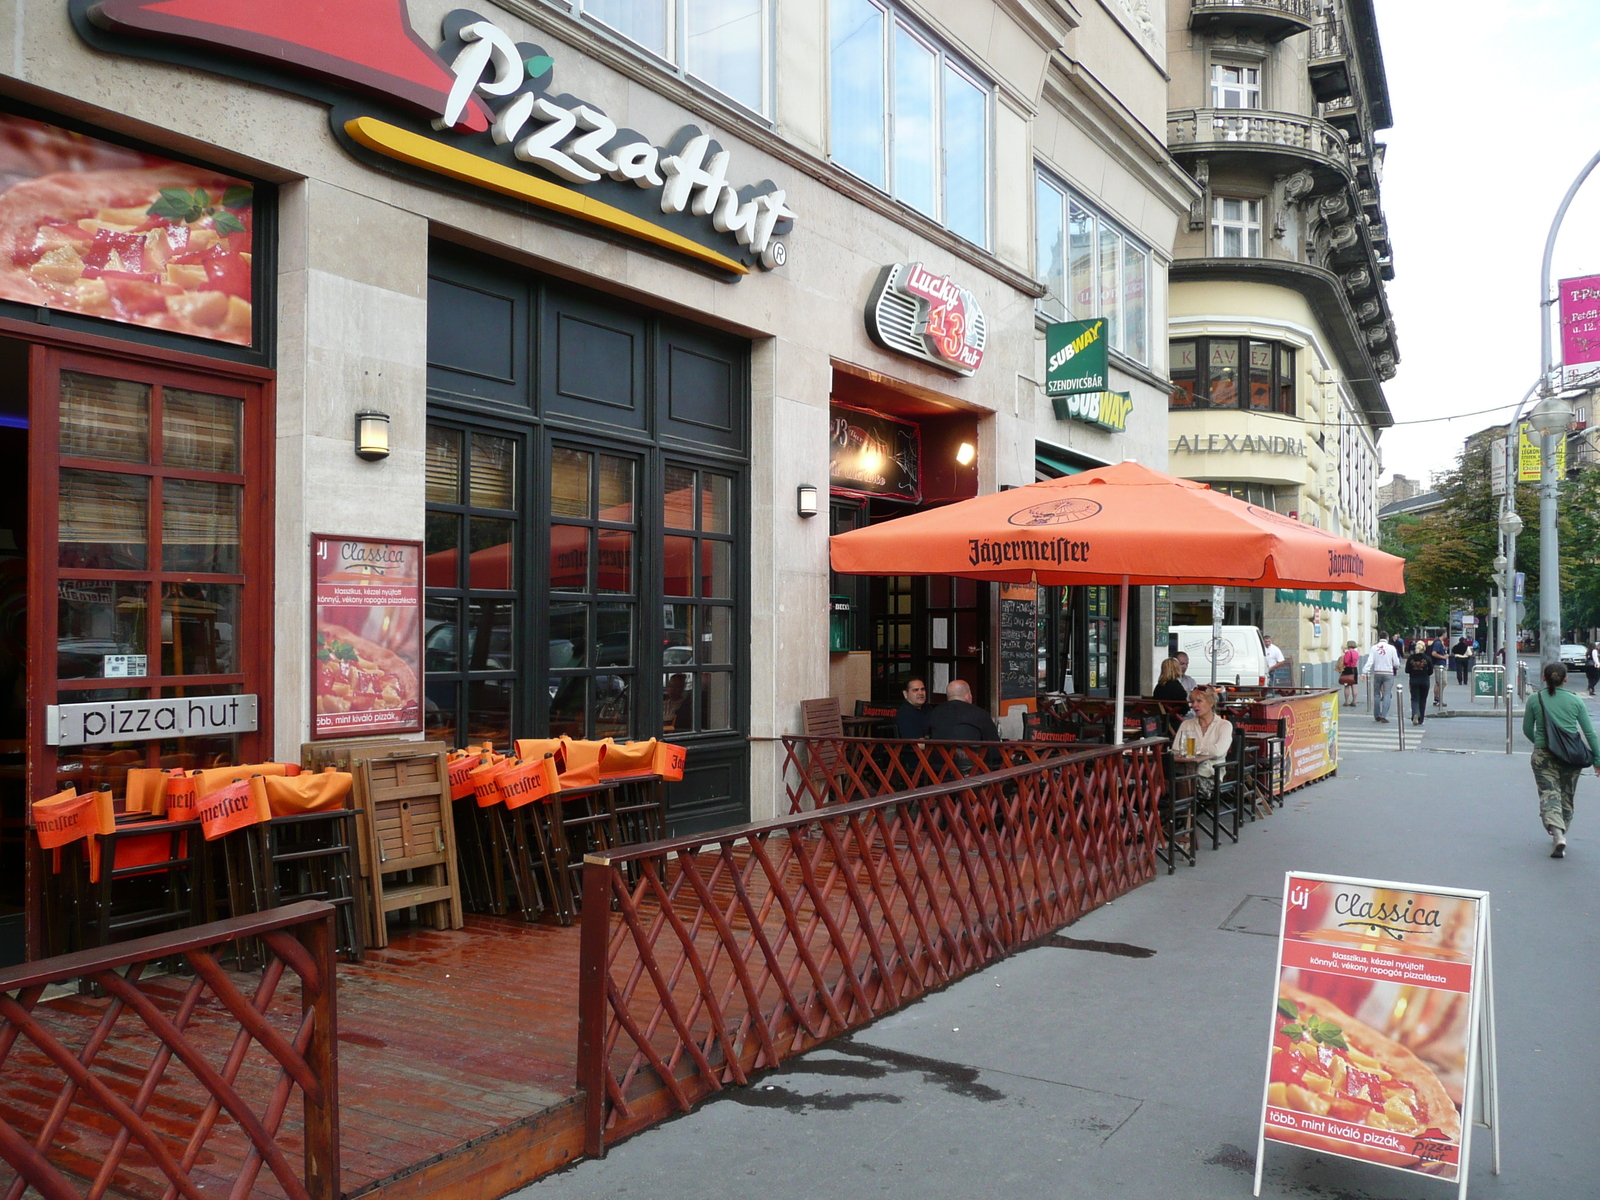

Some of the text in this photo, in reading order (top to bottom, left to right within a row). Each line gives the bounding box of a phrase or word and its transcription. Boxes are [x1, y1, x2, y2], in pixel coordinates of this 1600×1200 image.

[431, 21, 798, 254] Pizza Hut
[910, 263, 961, 311] Lucky
[930, 305, 965, 357] 13
[1583, 322, 1598, 332] 12.
[959, 346, 980, 365] Pub
[1048, 320, 1103, 373] SUBWAY
[1048, 373, 1103, 392] SZENDVICSBÁR
[1067, 391, 1133, 430] SUBWAY
[1174, 433, 1308, 458] ALEXANDRA
[341, 542, 405, 563] Classica
[968, 537, 1090, 566] Jägermeister
[83, 697, 239, 742] pizza hut
[352, 713, 373, 723] kiváló
[1290, 885, 1442, 928] új Classica
[1309, 956, 1447, 983] könnyű, vékony ropogós pizzatészta
[1332, 951, 1425, 971] klasszikus, kézzel nyújtott
[1269, 1110, 1400, 1149] több, mint kiváló pizzák
[1411, 1141, 1453, 1156] Pizza
[1419, 1150, 1448, 1162] Hut
